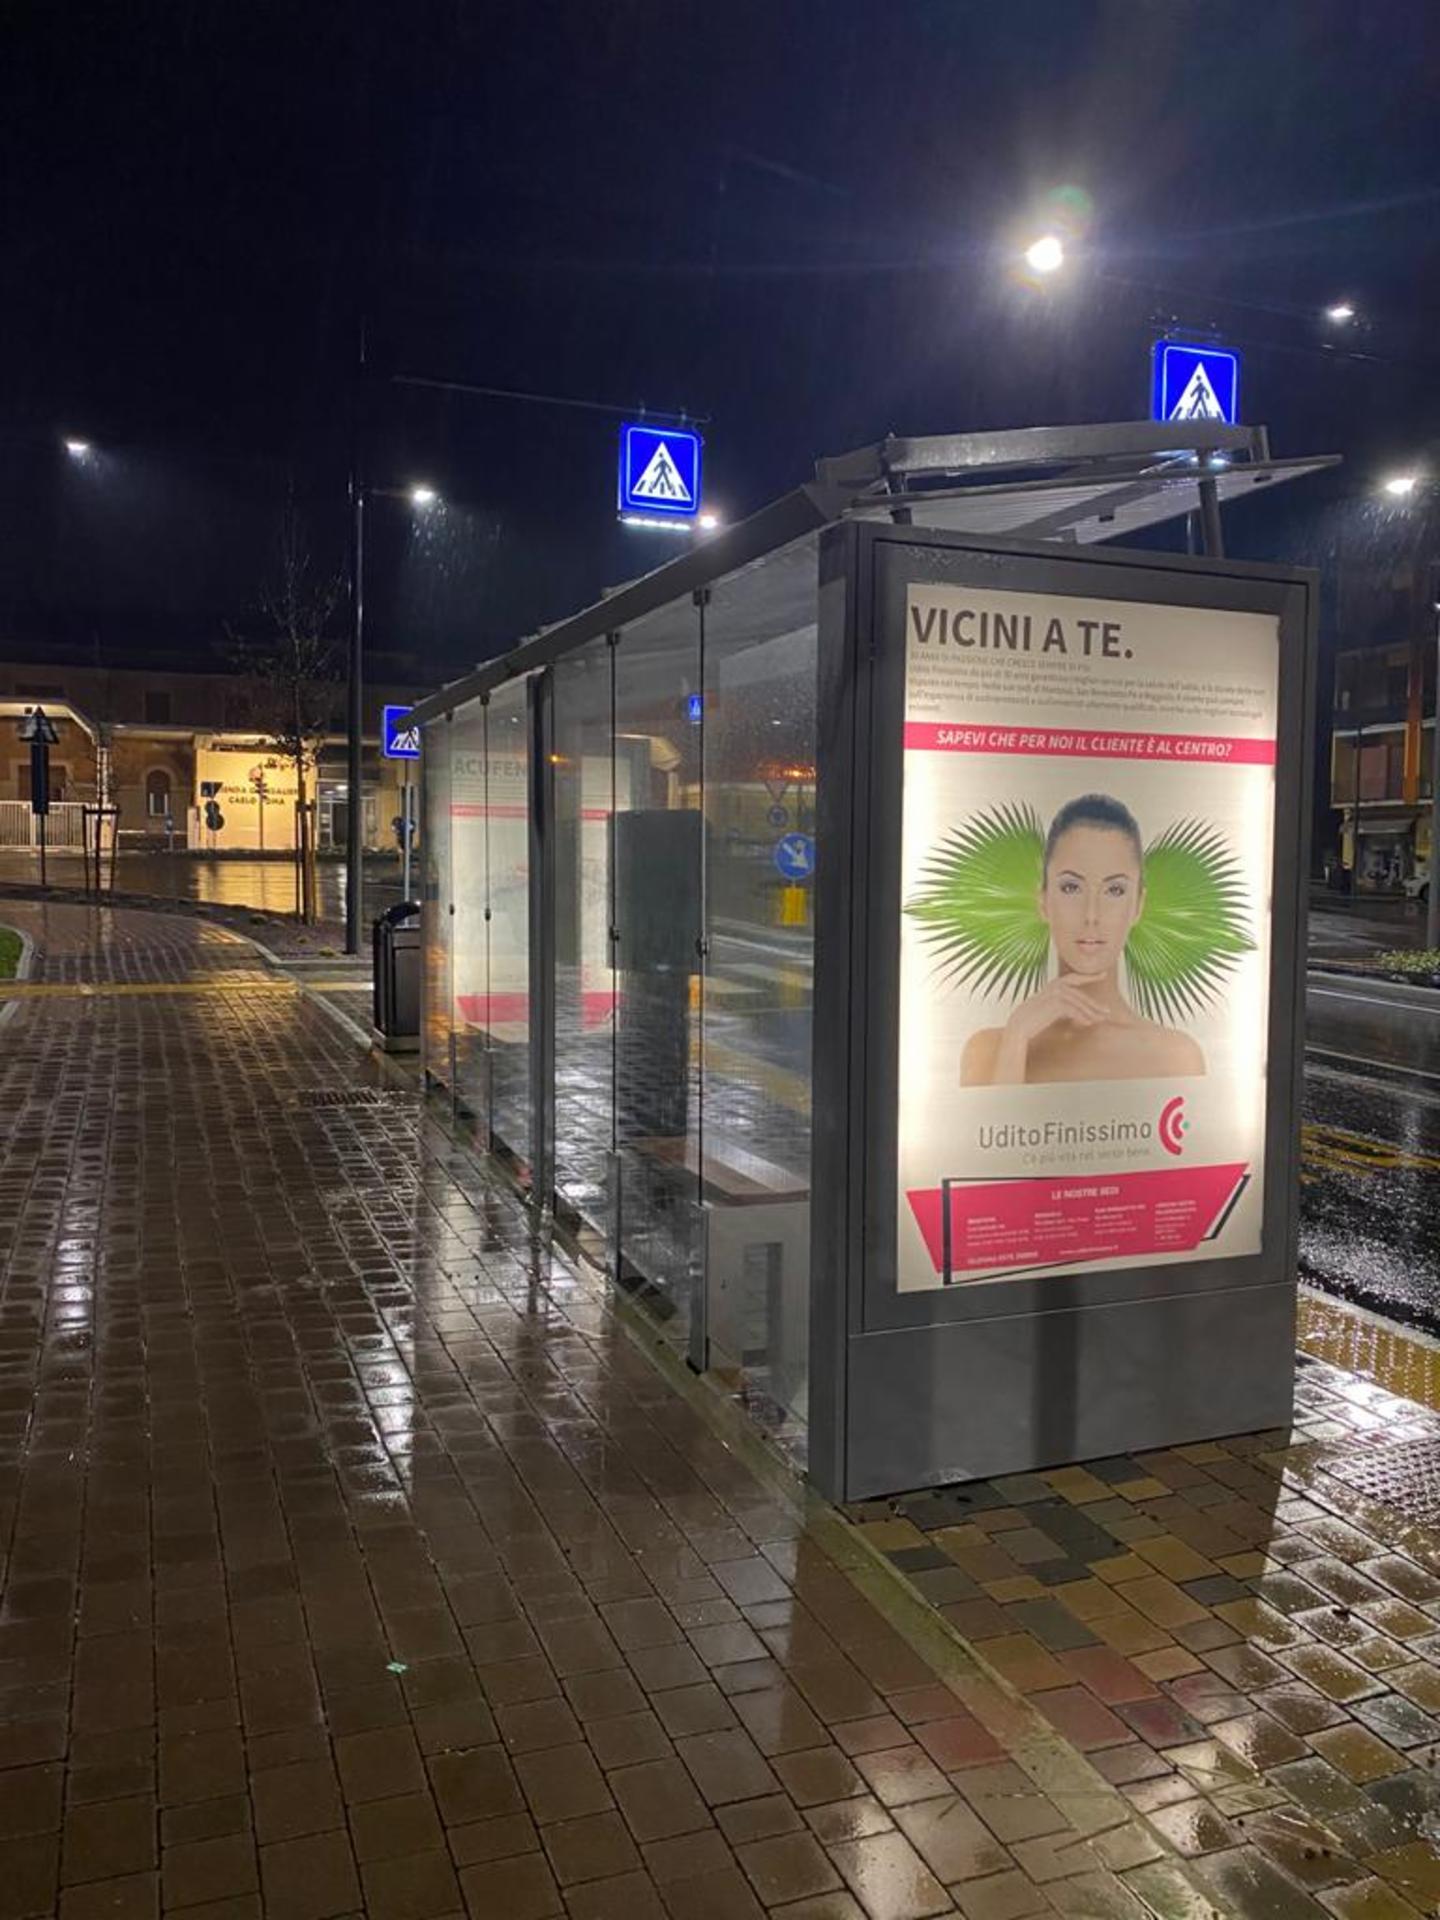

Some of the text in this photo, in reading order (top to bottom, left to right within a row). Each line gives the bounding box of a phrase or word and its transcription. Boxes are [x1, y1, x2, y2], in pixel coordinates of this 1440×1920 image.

[911, 605, 1133, 660] VICINI A TE.
[937, 729, 986, 746] SAPEVI
[989, 732, 1016, 747] CHE
[1019, 733, 1046, 748] PER
[1048, 735, 1073, 749] NOI
[1075, 736, 1087, 750] IL
[1090, 737, 1144, 753] CLIENTE
[1157, 740, 1173, 755] AL
[1175, 741, 1233, 757] CENTRO?
[979, 1119, 1152, 1149] UditoFinissimo
